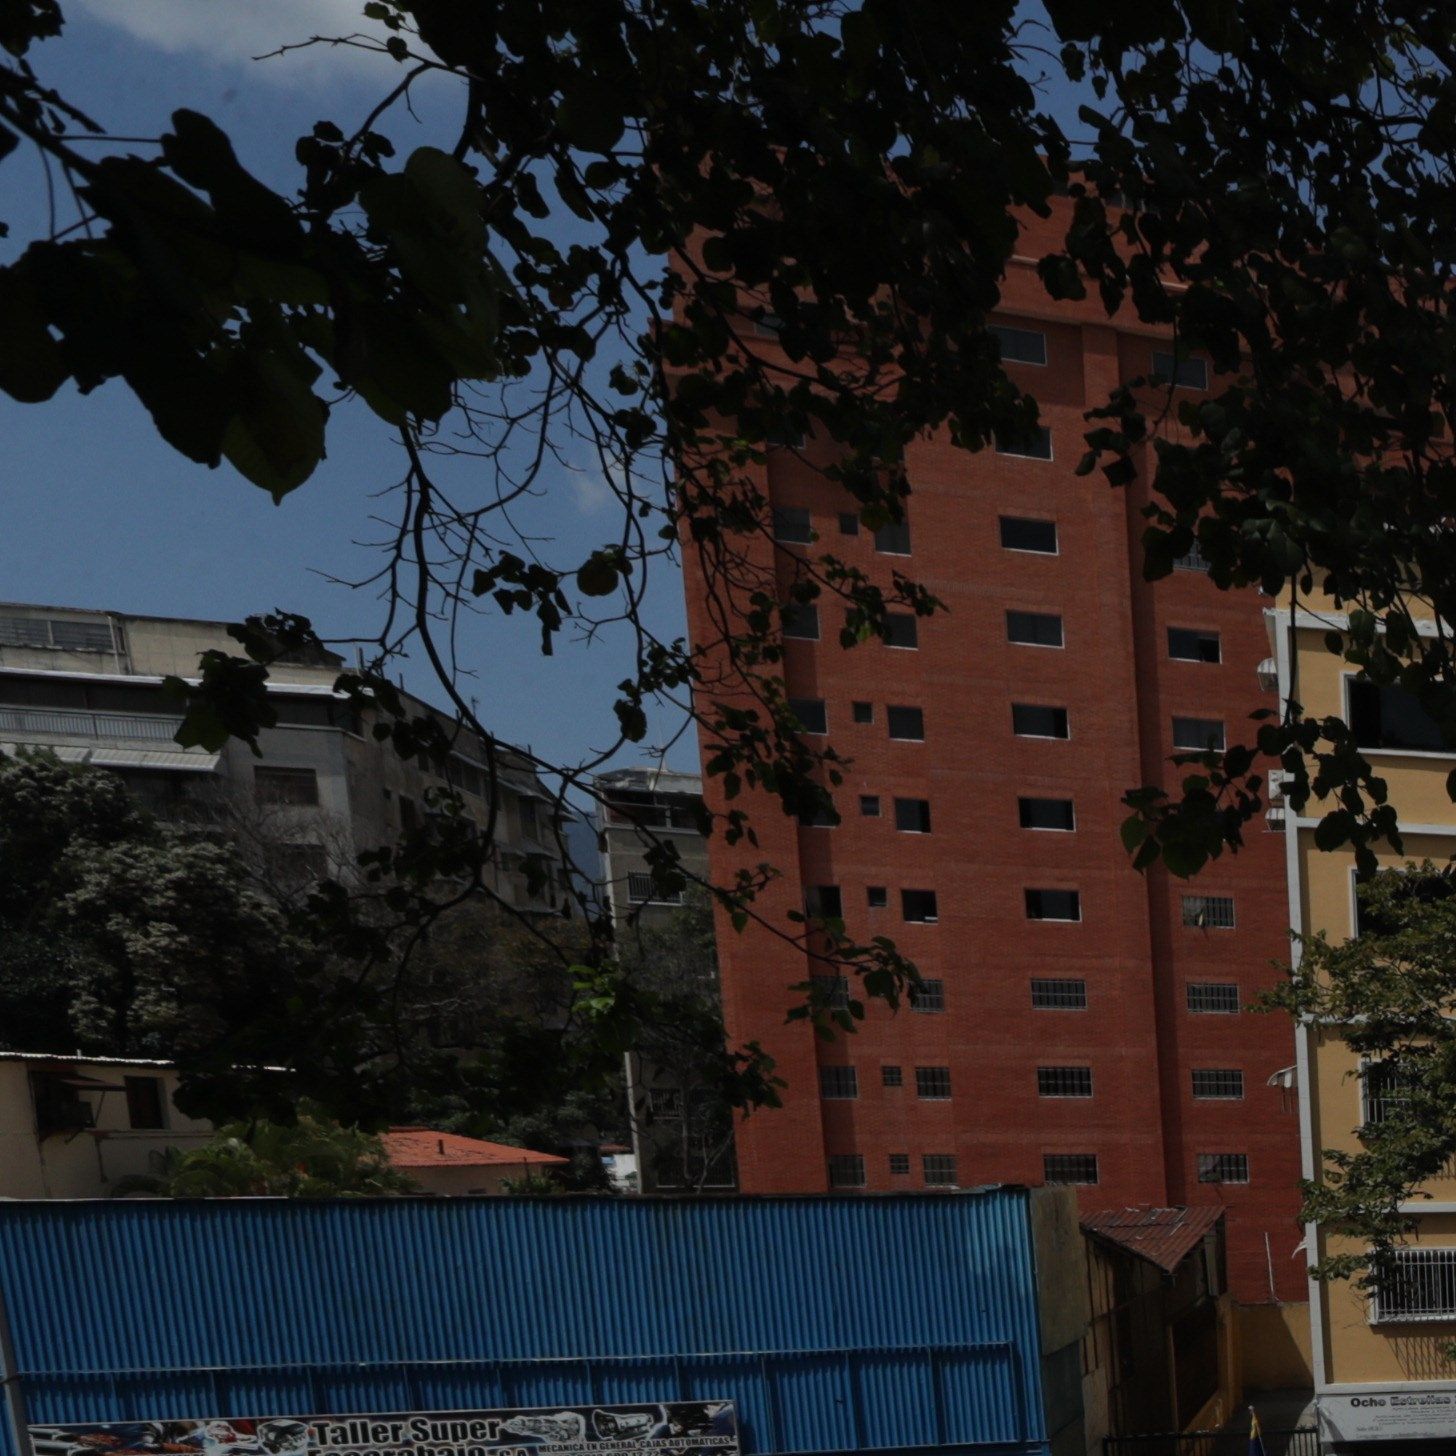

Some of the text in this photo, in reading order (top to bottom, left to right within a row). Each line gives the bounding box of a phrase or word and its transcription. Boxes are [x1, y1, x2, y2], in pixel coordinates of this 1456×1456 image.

[1350, 1397, 1386, 1407] Ocho
[312, 1417, 500, 1446] Taller Super
